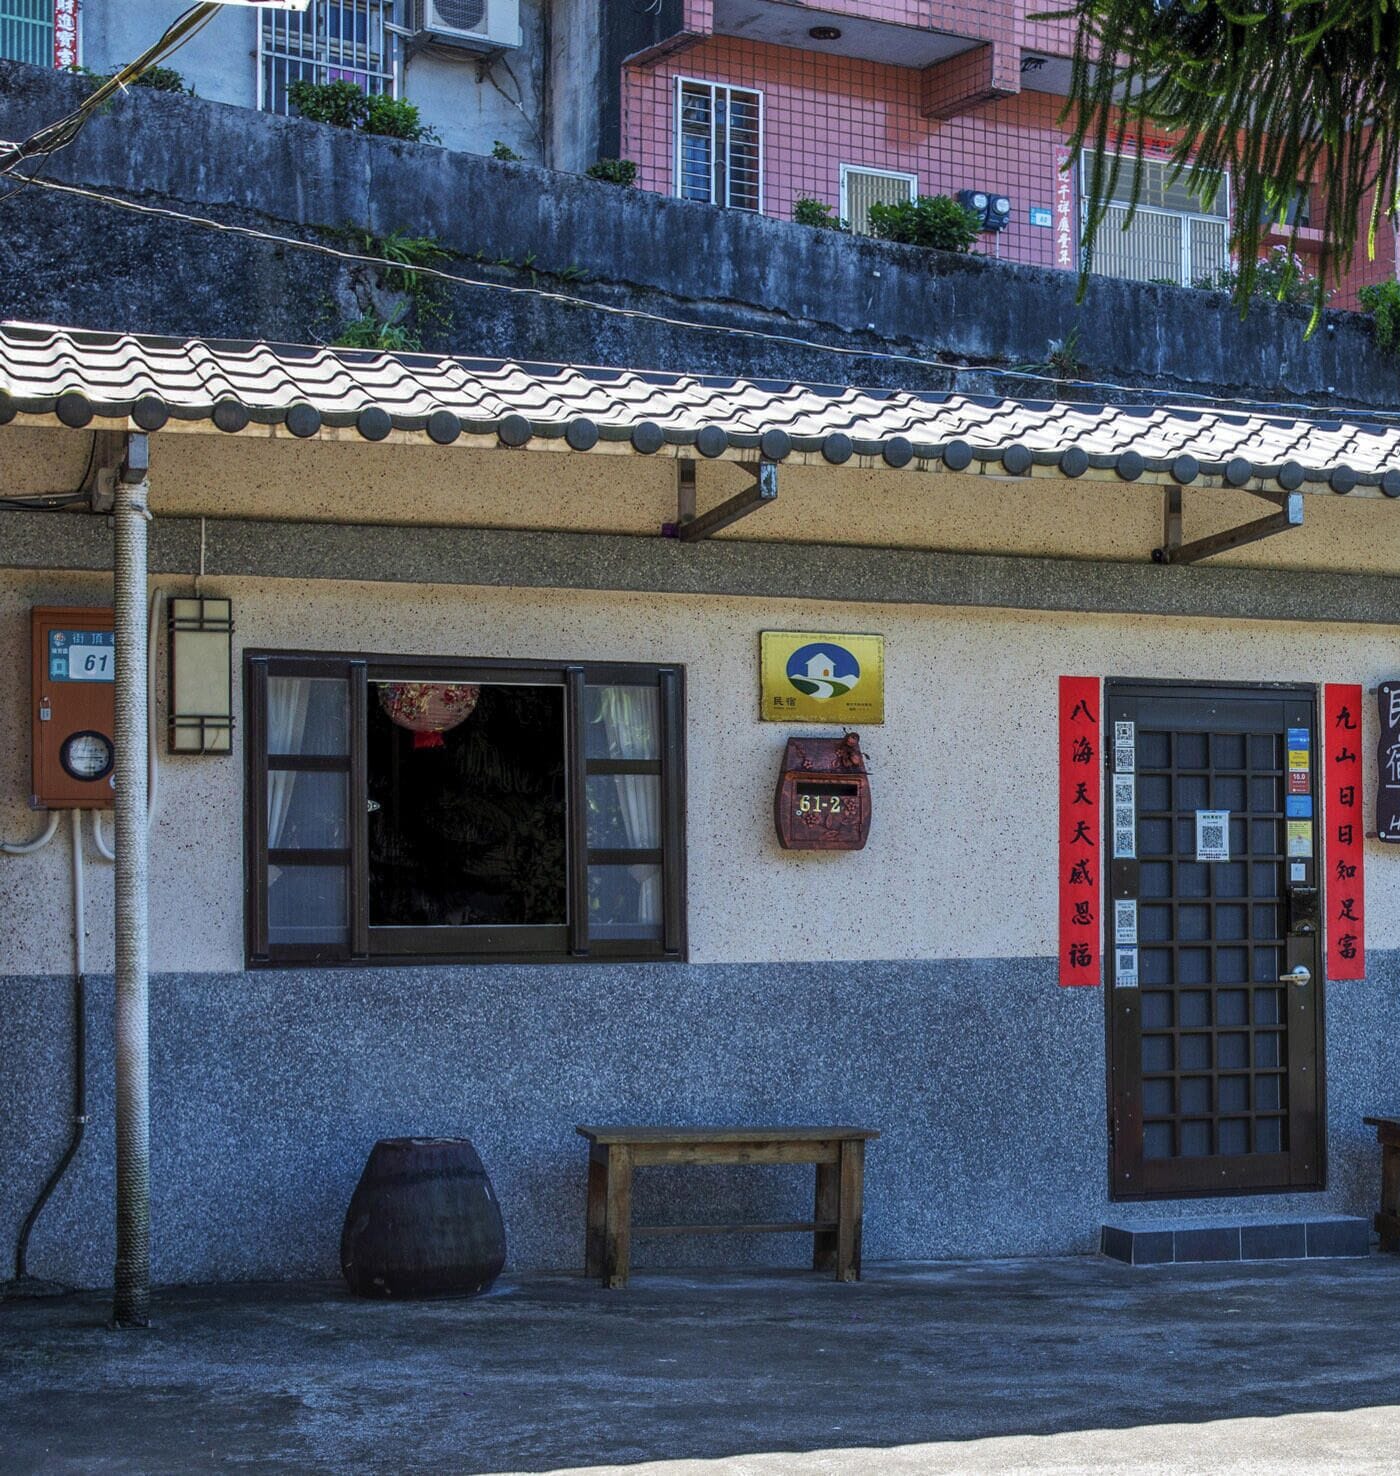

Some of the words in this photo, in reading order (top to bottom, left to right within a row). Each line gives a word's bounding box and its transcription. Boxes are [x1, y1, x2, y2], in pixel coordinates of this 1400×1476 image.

[84, 654, 108, 672] 61
[800, 794, 841, 813] 61-2
[1069, 699, 1096, 968] 八海天天感恩福
[1335, 706, 1359, 960] 九山日日知足富
